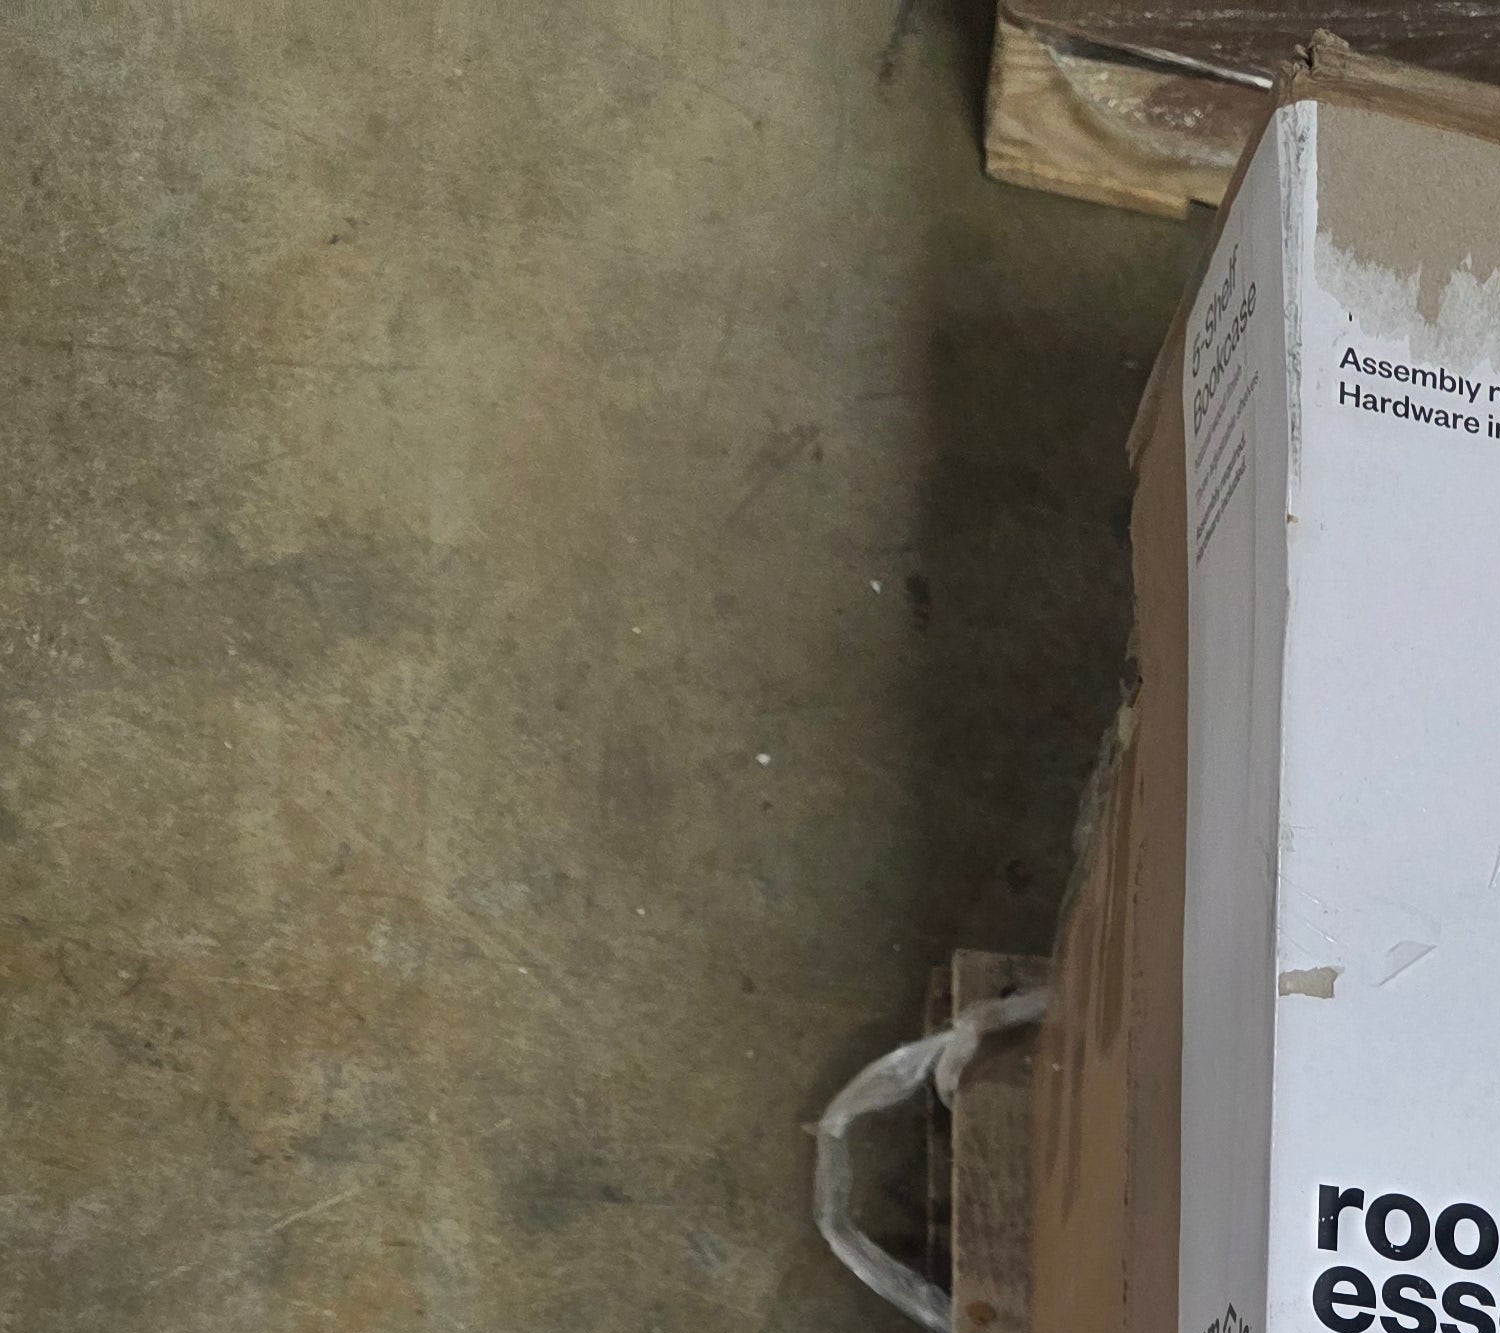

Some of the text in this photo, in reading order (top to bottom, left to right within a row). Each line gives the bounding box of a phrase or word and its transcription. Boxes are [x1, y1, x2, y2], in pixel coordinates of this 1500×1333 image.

[1193, 282, 1257, 438] Bookcase
[1339, 347, 1482, 403] Assembly
[1339, 381, 1480, 434] Hardware
